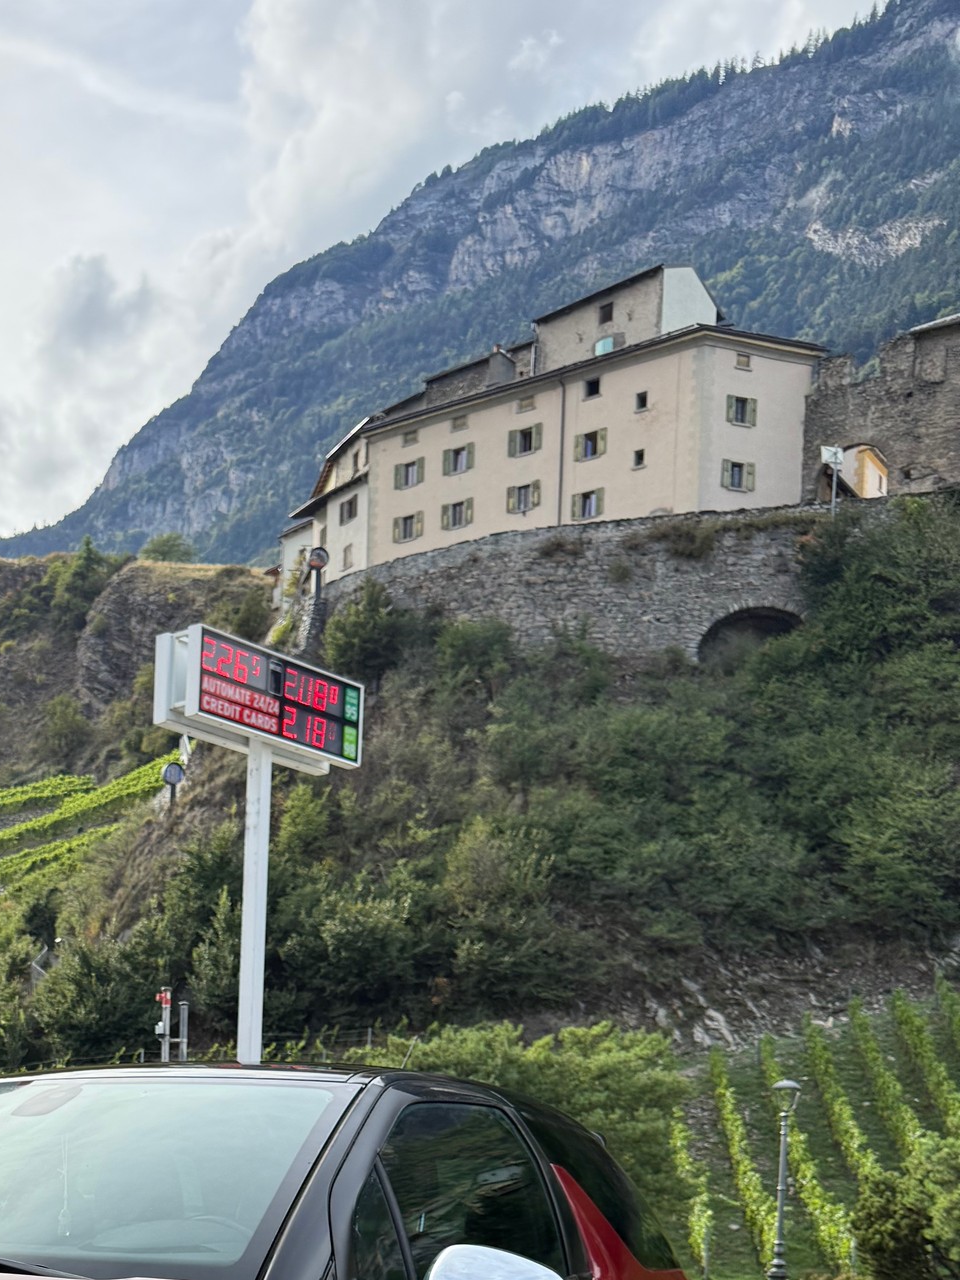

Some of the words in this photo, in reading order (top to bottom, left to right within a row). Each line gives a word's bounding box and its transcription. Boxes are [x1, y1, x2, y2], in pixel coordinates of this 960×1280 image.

[202, 677, 251, 705] AUTOMATE
[253, 693, 280, 716] 24/24
[203, 695, 241, 720] CREDIT
[243, 709, 278, 732] CARDS
